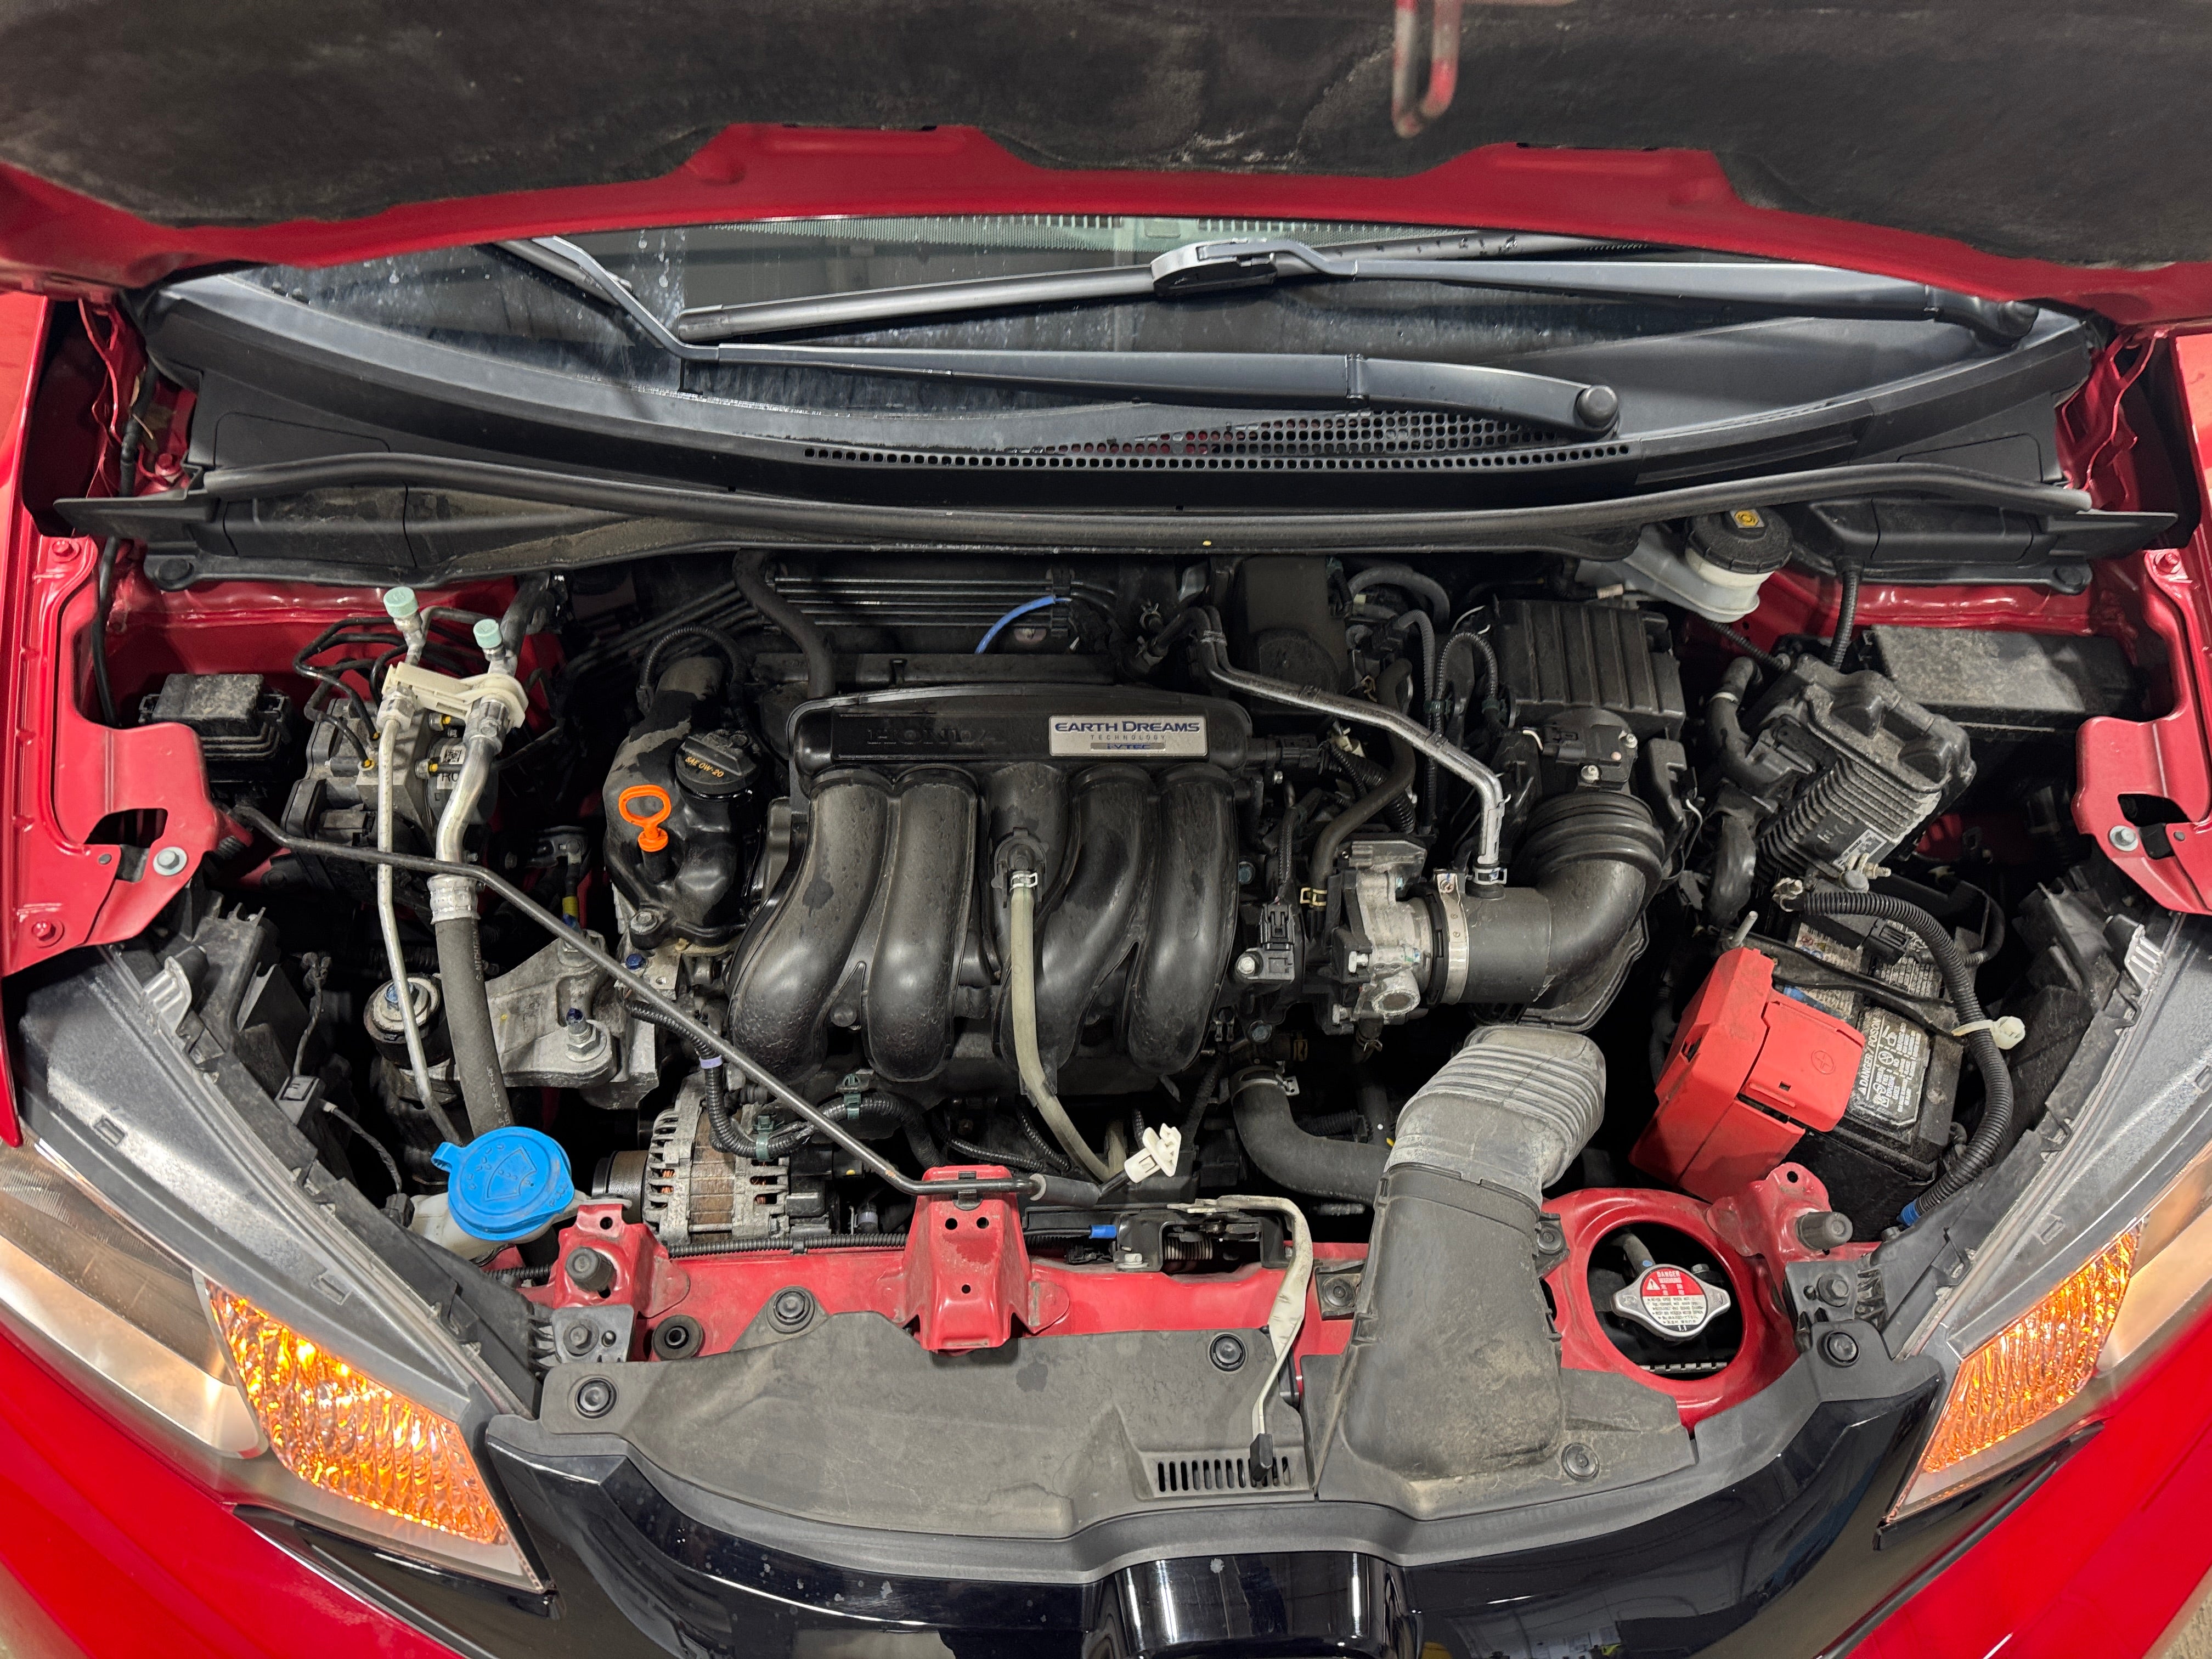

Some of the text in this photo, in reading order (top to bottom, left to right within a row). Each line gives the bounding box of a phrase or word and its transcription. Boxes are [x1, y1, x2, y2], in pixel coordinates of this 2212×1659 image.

[1054, 721, 1200, 732] EARTH DREAMS
[685, 757, 700, 766] SAE
[1859, 1053, 1874, 1087] DANGER
